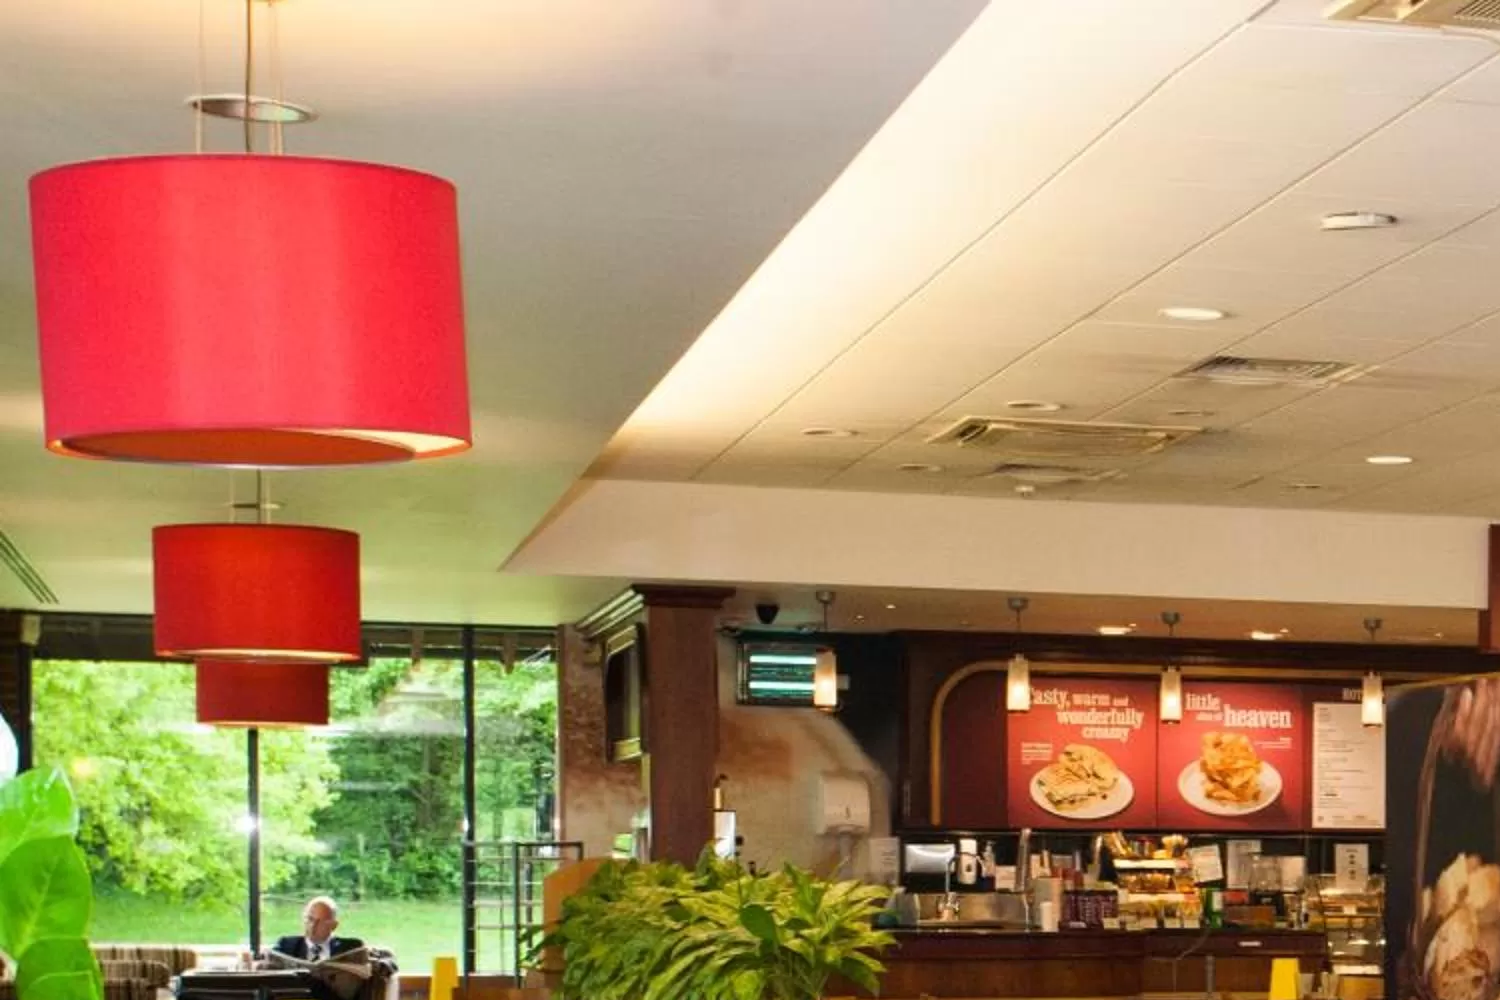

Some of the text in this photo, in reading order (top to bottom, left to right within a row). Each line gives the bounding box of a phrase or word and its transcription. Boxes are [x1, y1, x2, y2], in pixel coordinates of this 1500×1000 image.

[1029, 687, 1071, 710] asty,
[1056, 707, 1144, 729] wonderfully
[1223, 703, 1293, 729] heaven
